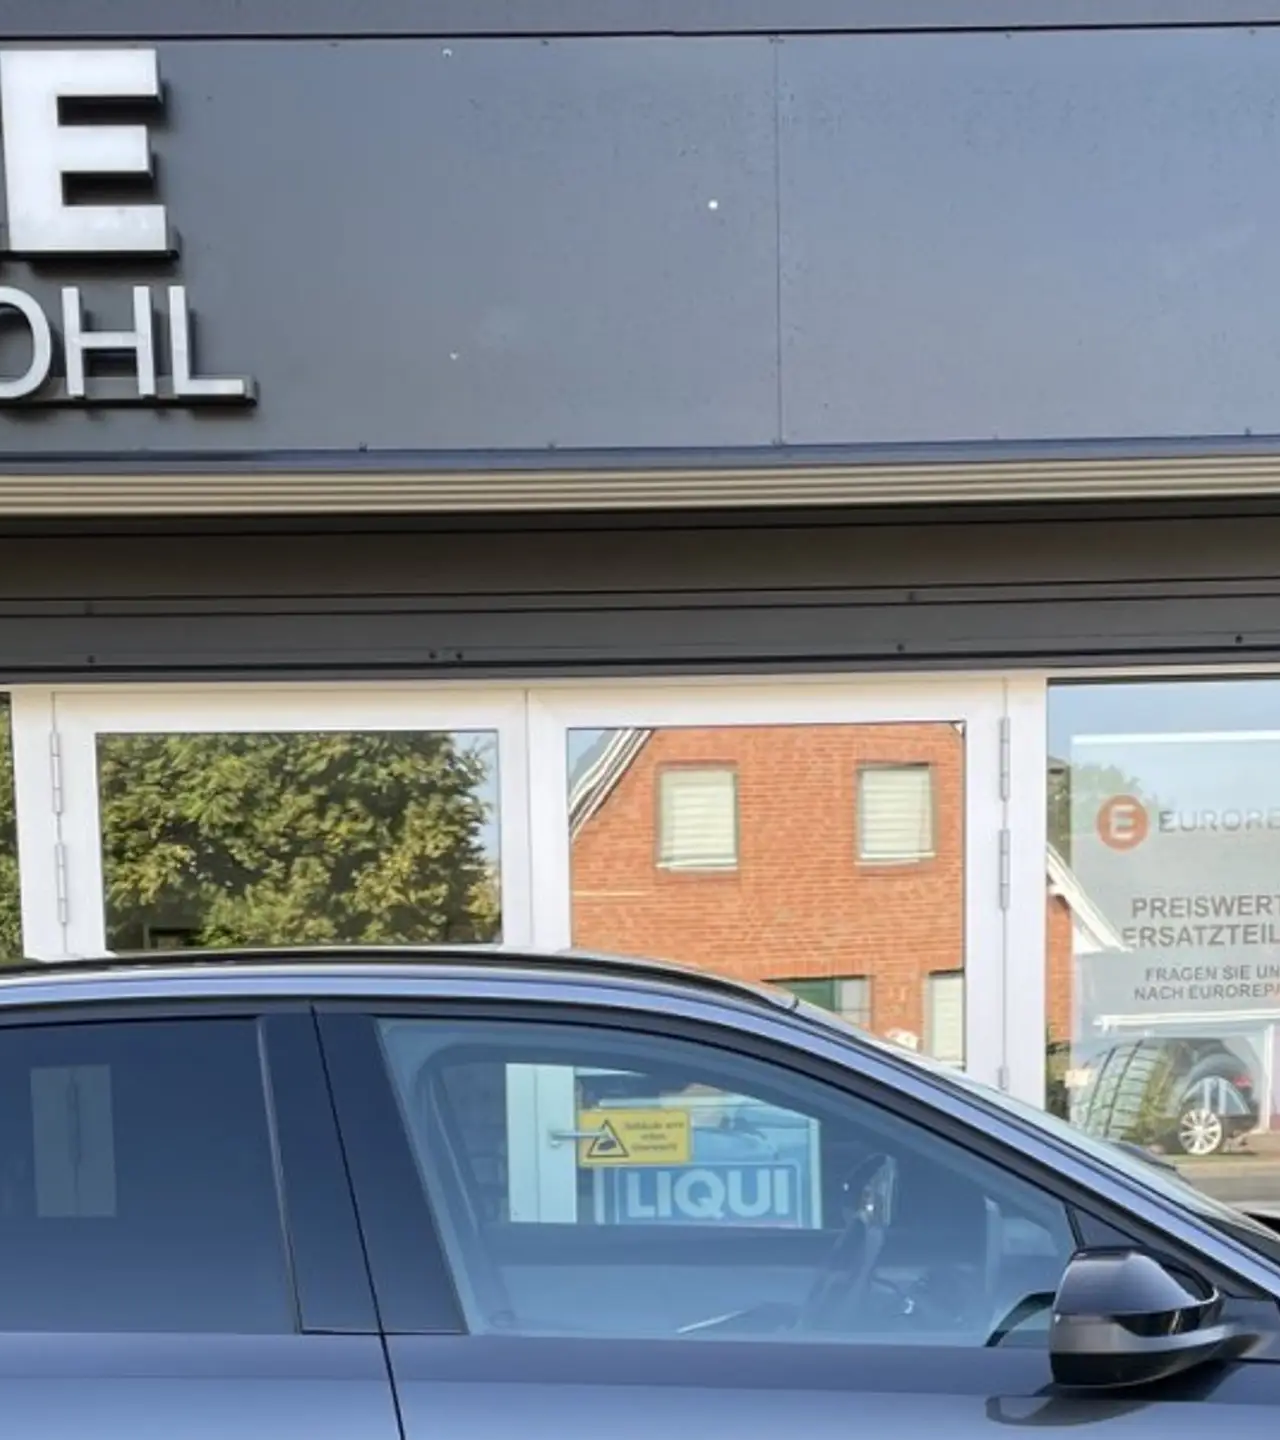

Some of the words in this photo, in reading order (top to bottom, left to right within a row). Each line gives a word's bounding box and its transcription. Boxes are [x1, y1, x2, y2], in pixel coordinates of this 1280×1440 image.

[1145, 965, 1218, 982] FRAGEN
[1222, 964, 1251, 981] SIE
[1133, 985, 1184, 1001] NACH
[625, 1167, 791, 1221] LIQUI
